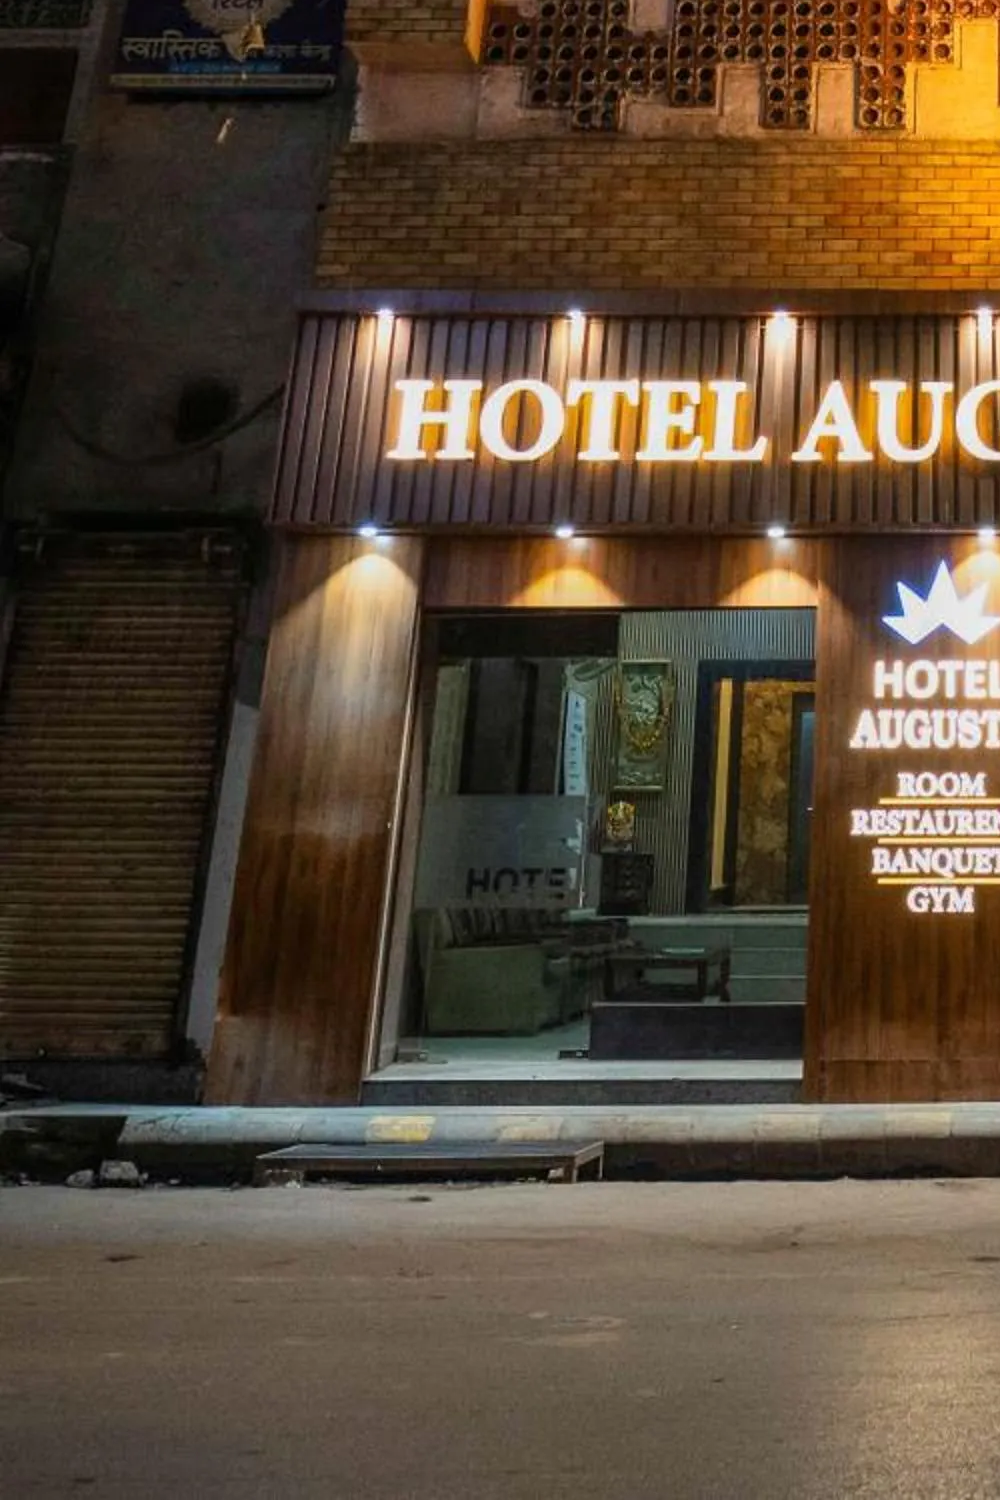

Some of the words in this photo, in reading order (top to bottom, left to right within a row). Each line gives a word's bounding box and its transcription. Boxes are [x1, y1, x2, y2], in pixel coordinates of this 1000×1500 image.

[384, 377, 768, 464] HOTEL
[897, 772, 988, 797] ROOM
[907, 887, 975, 914] GYM
